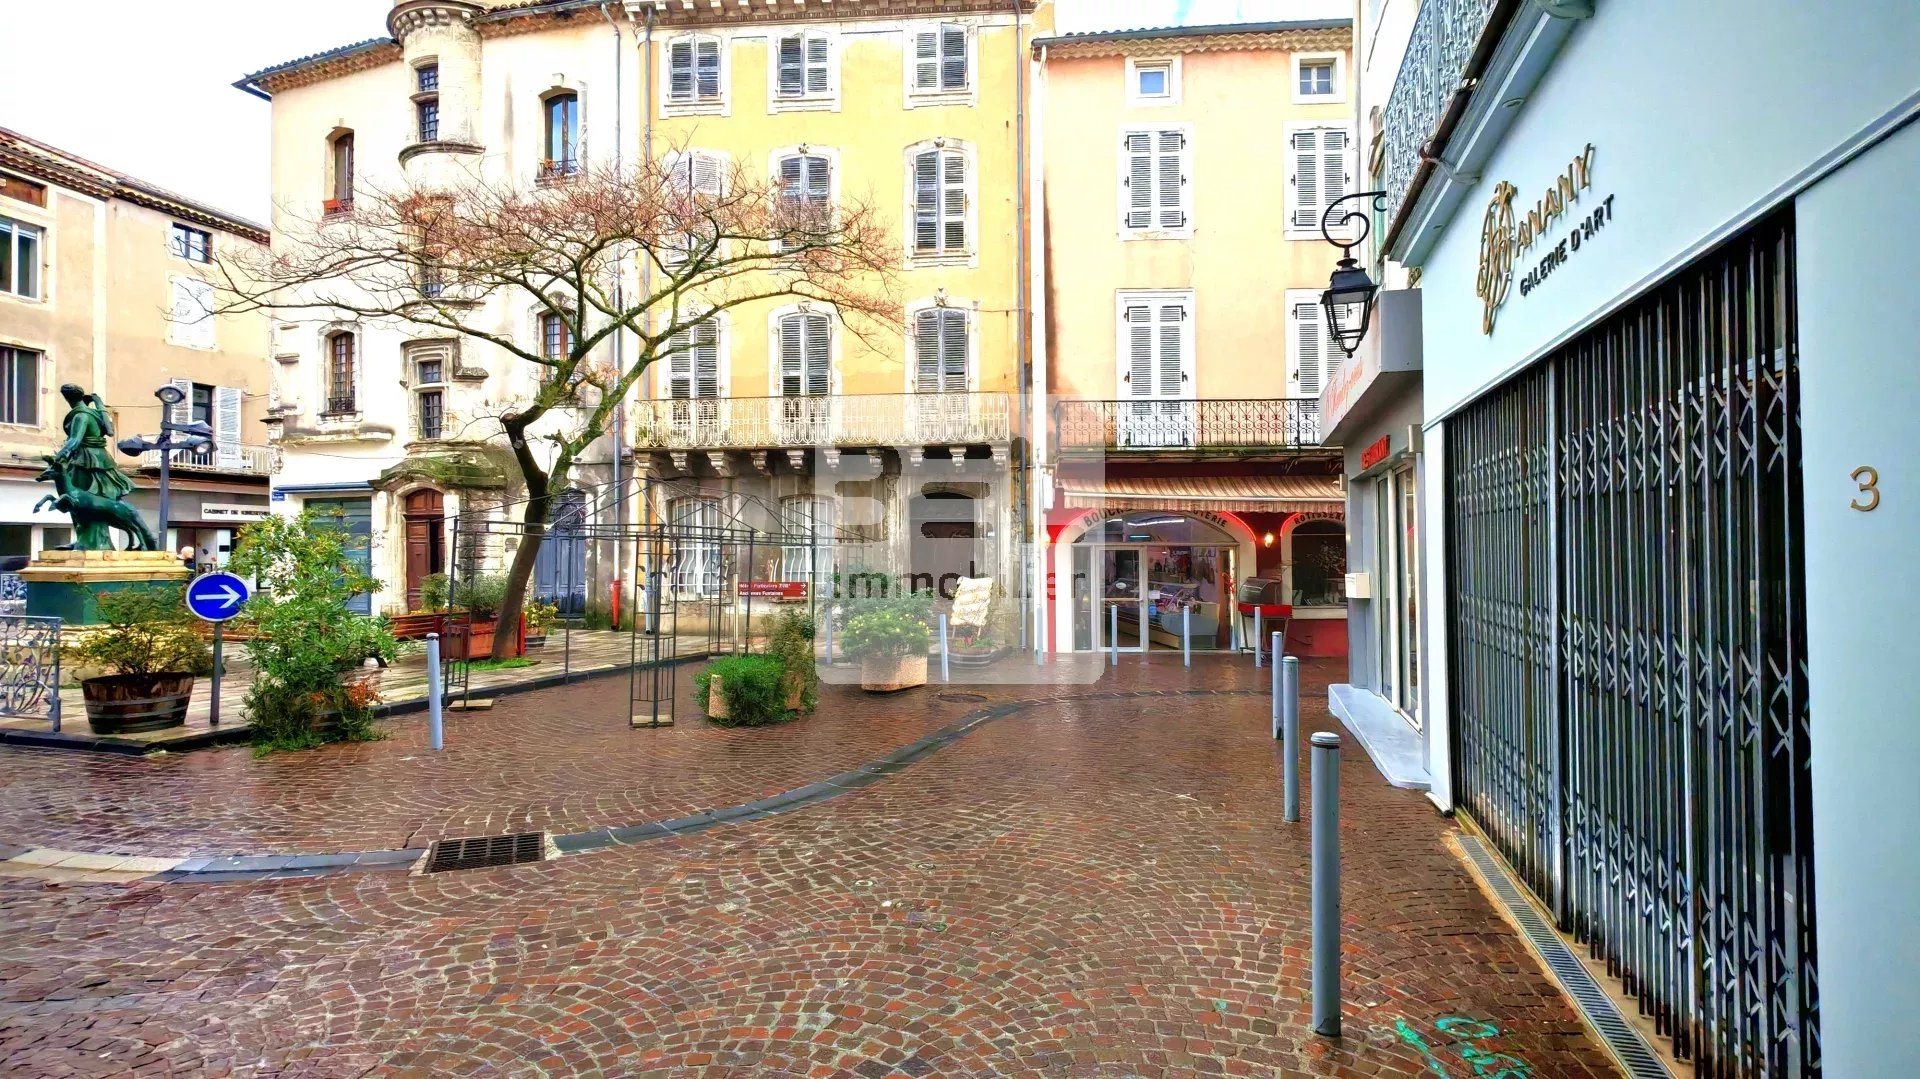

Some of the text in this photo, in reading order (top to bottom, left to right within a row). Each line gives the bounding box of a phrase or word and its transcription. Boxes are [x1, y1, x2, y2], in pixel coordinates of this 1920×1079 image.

[1520, 194, 1614, 297] GALERIE D'ART
[1850, 465, 1880, 512] 3
